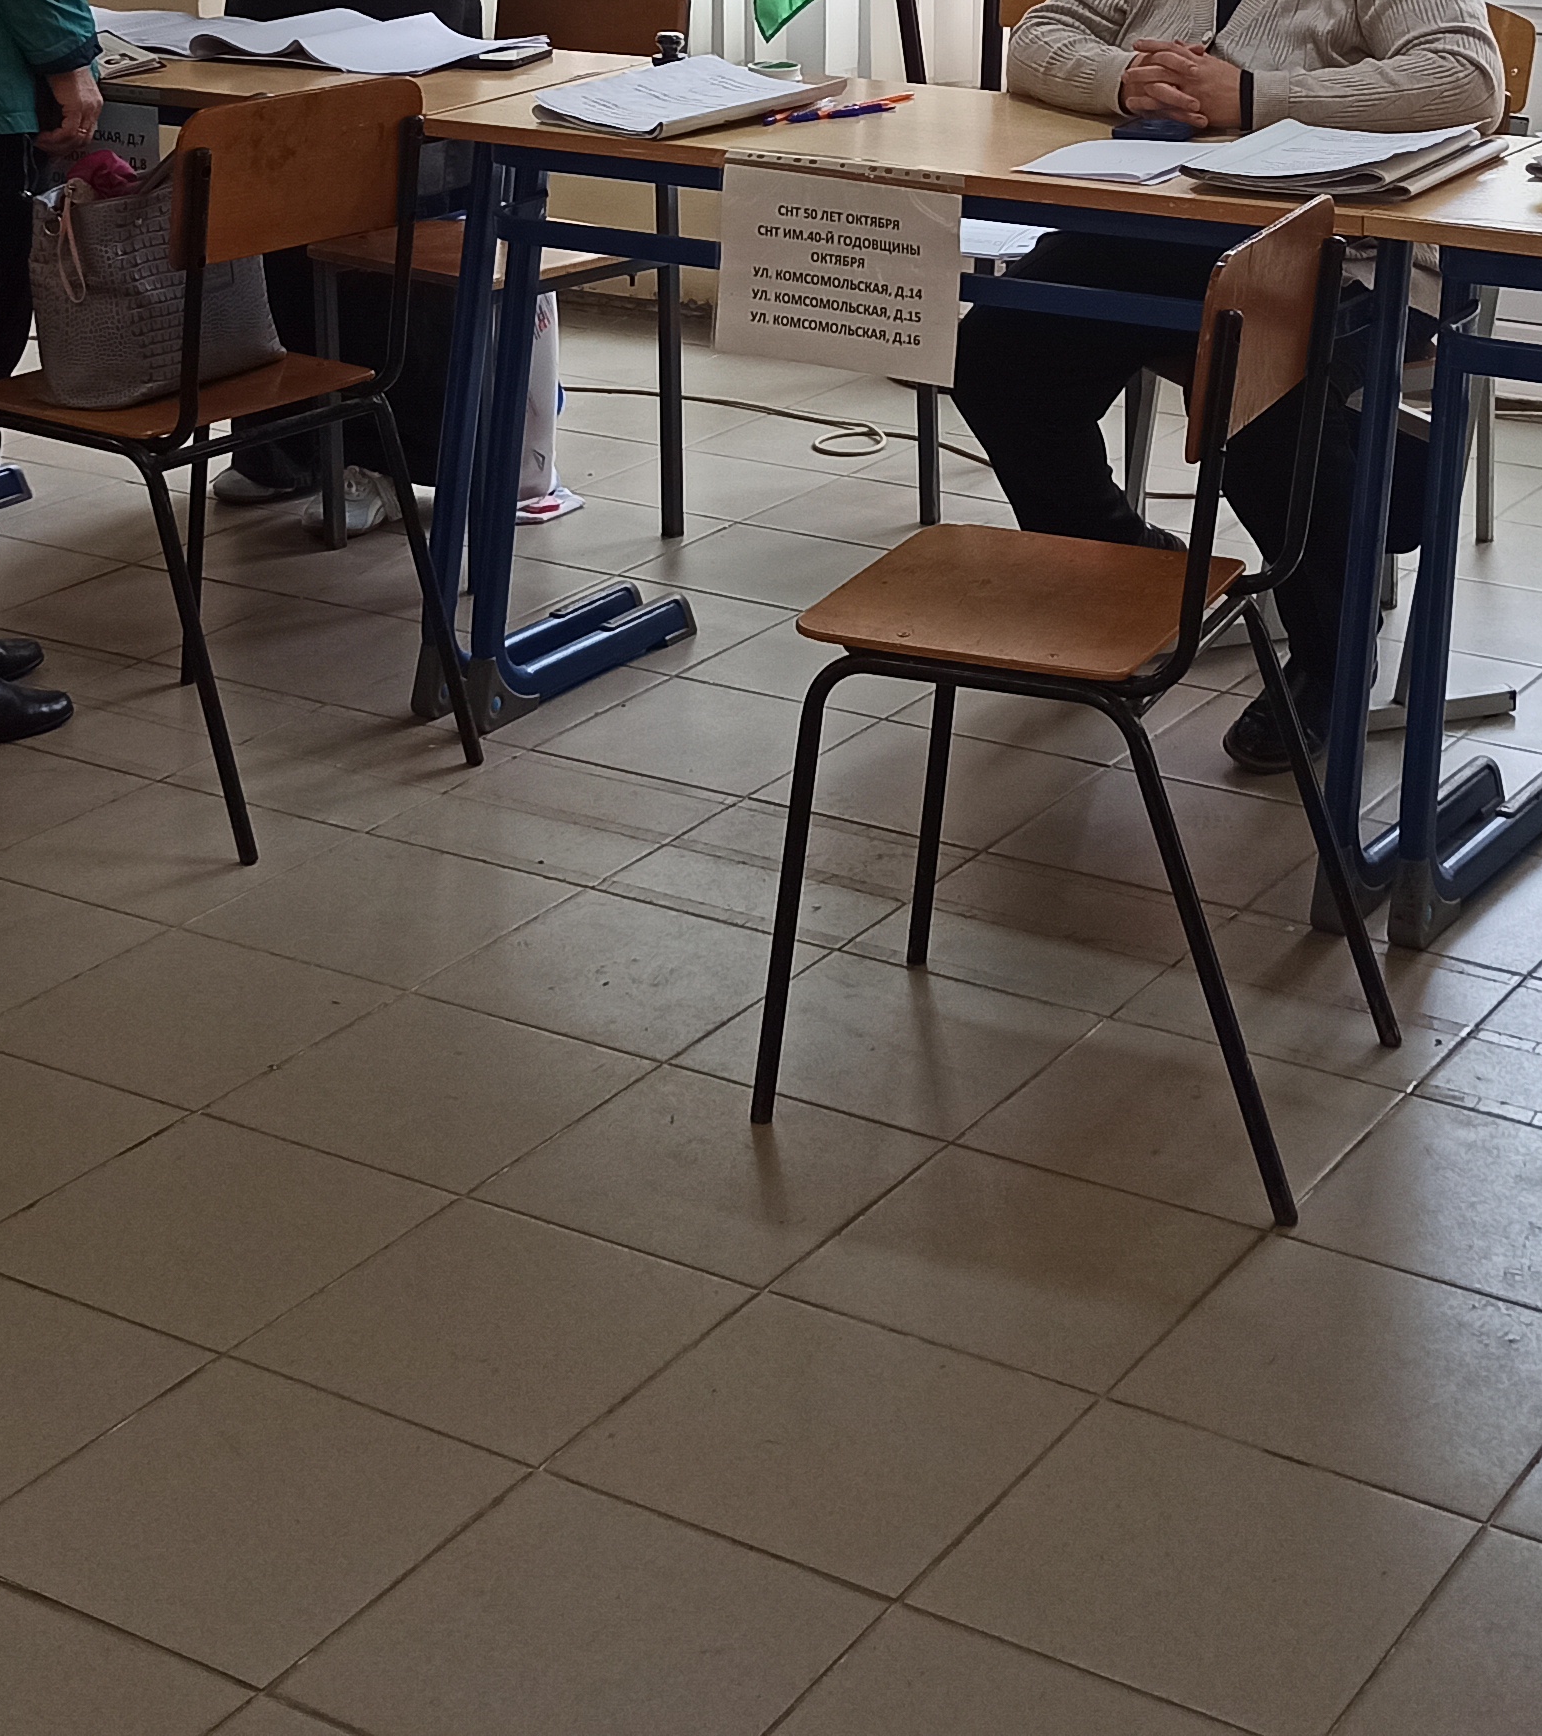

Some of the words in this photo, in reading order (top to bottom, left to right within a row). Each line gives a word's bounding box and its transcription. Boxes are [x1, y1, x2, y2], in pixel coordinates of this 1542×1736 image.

[127, 133, 145, 147] Д.7
[778, 205, 801, 218] СНТ
[804, 206, 818, 220] 50
[820, 210, 843, 223] ЛЕТ
[846, 213, 900, 230] ОКТЯБРЯ
[757, 225, 780, 238] СНТ
[783, 227, 834, 245] ИМ.40-Й
[837, 234, 920, 256] ГОДОВЩИНЫ
[811, 251, 865, 269] ОКТЯБРЯ
[753, 267, 772, 279] УЛ.
[775, 269, 892, 298] КОМСОМОЛЬСКАЯ,
[894, 286, 923, 300] Д.14
[752, 289, 771, 302] УЛ.
[774, 291, 891, 321] КОМСОМОЛЬСКАЯ,
[893, 309, 921, 323] Д.15
[750, 311, 769, 324] УЛ.
[773, 314, 890, 344] КОМСОМОЛЬСКАЯ,
[892, 332, 921, 346] Д.16
